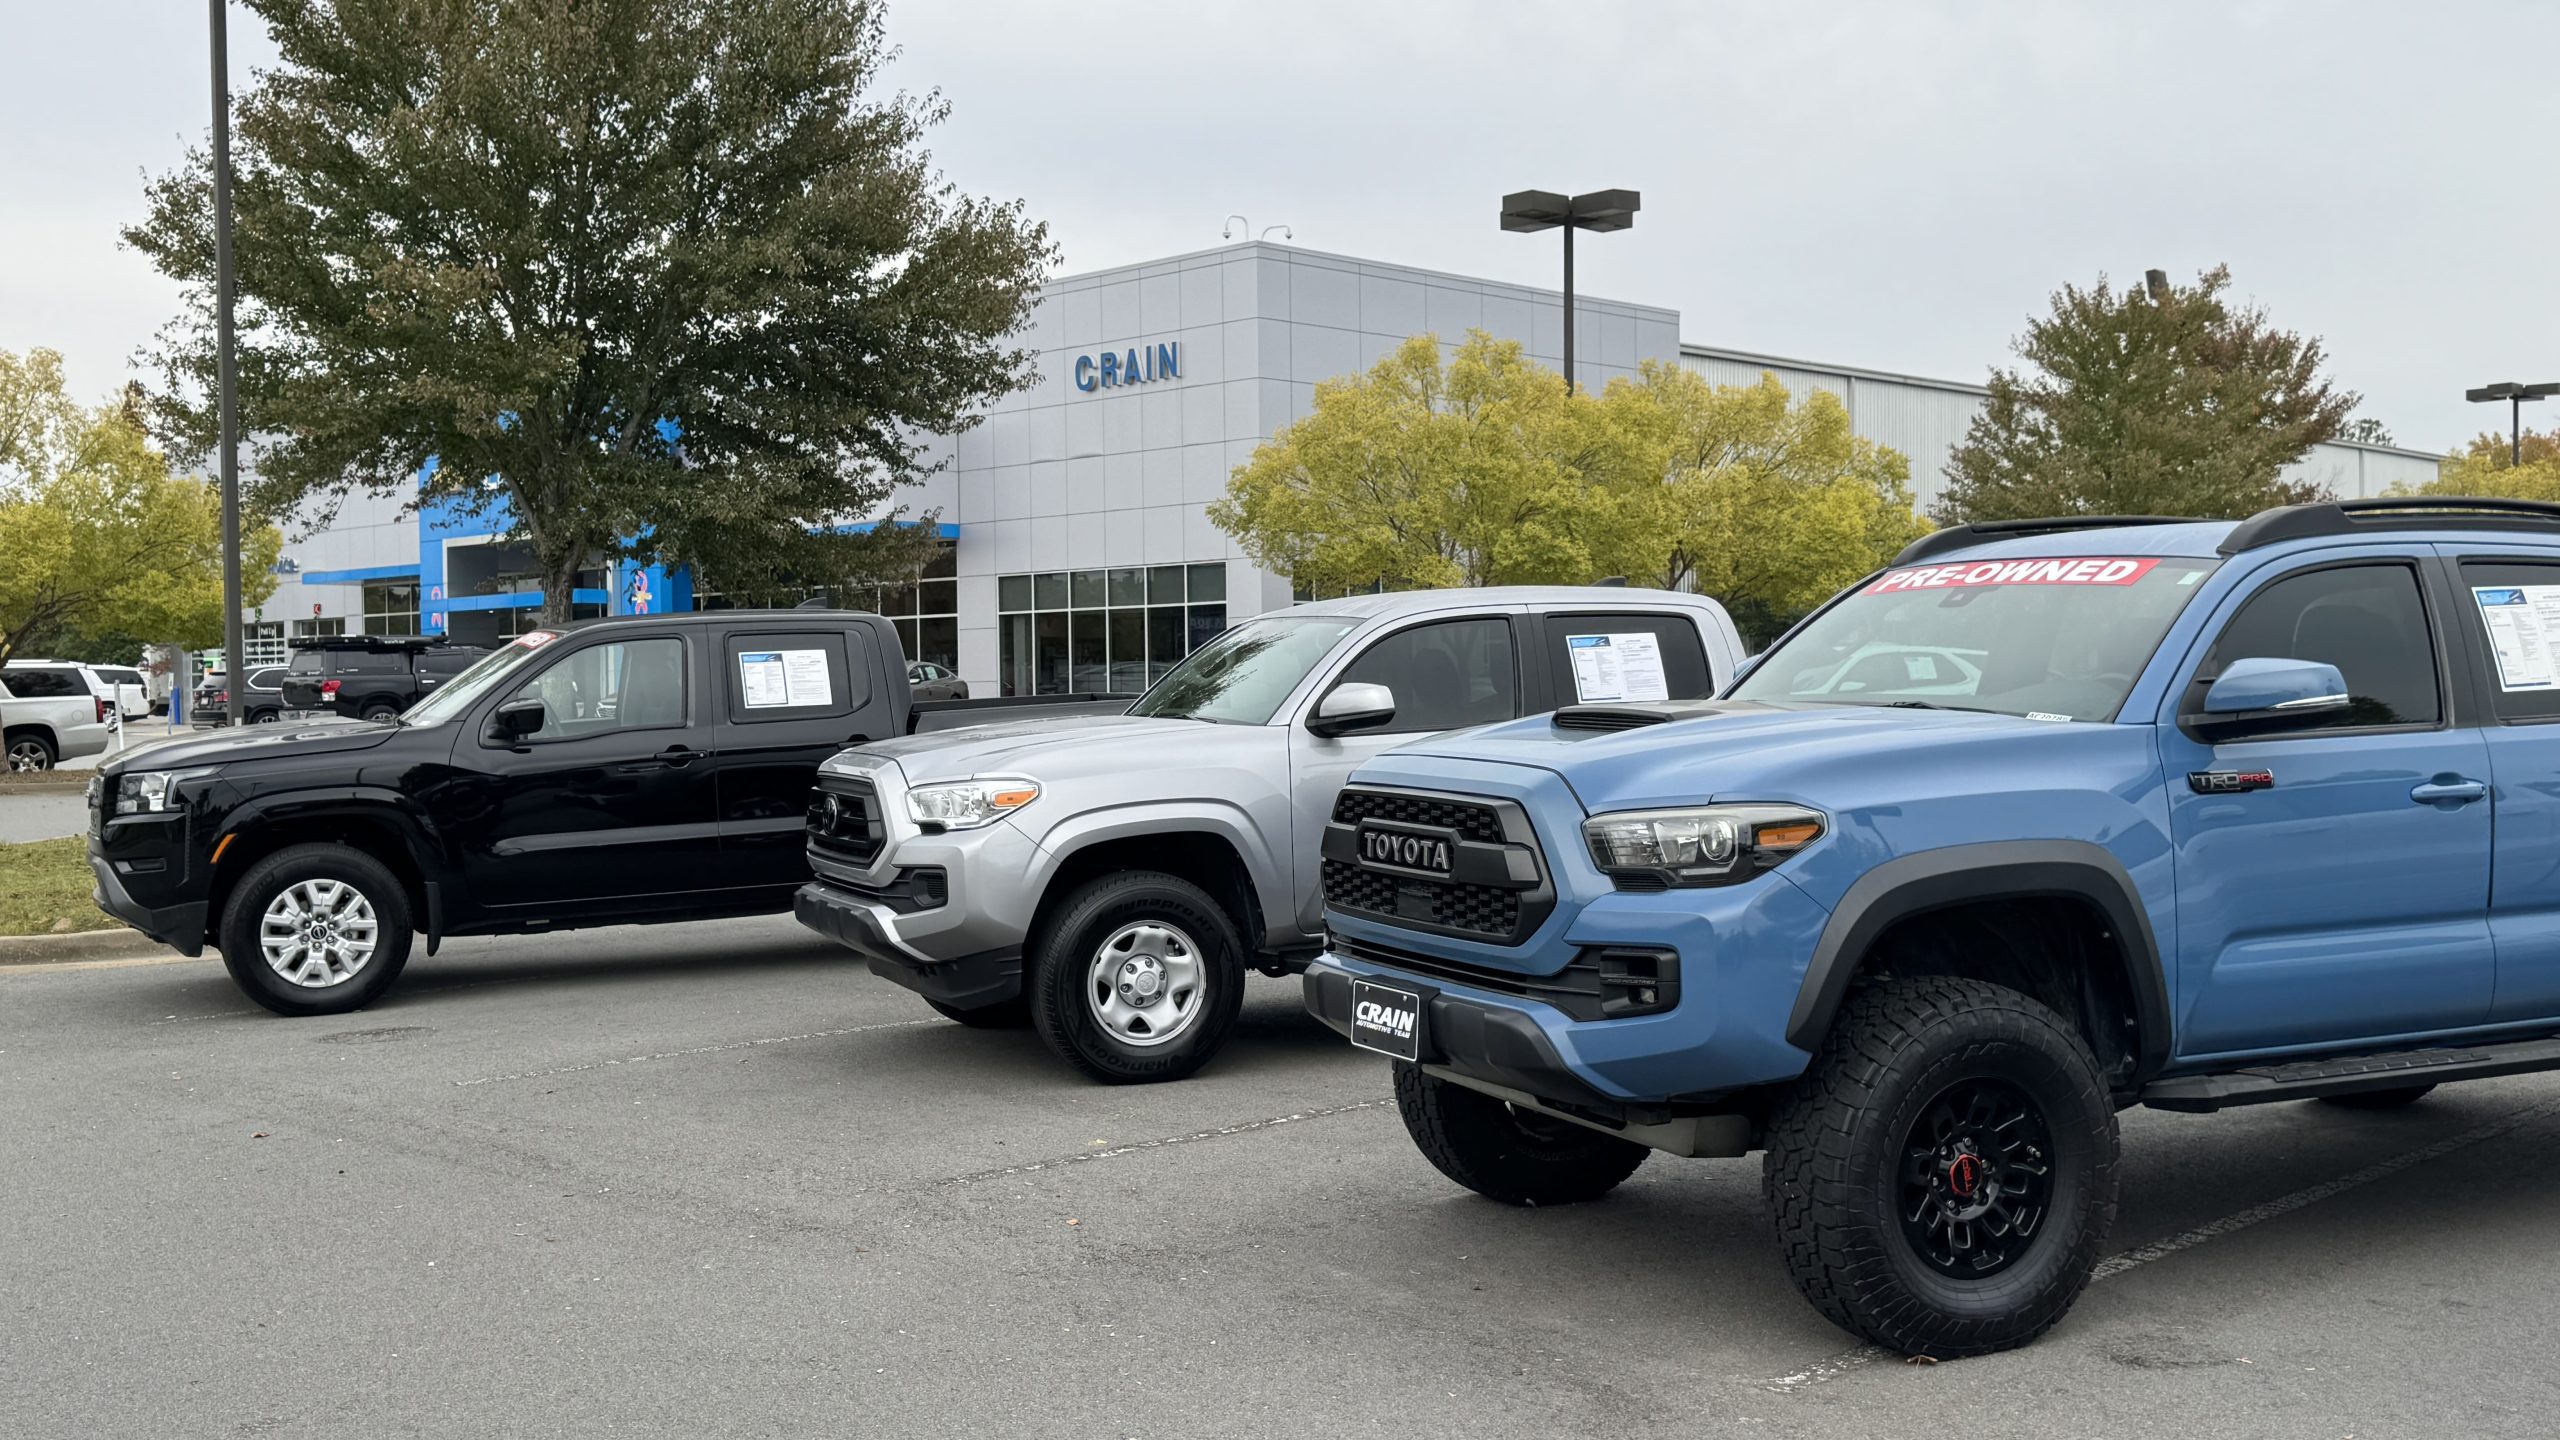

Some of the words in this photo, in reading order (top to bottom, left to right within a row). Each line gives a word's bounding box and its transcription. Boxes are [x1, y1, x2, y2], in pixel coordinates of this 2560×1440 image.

[1075, 341, 1181, 392] CRAIN
[1875, 560, 2139, 591] PRE-OWNED
[2194, 773, 2240, 790] TRD
[2240, 772, 2273, 783] PRO
[1364, 832, 1450, 870] TOYOTA
[1356, 1001, 1415, 1032] CRAIN
[1356, 1020, 1392, 1034] AUTOMOTIVE
[1394, 1030, 1411, 1039] TEAM
